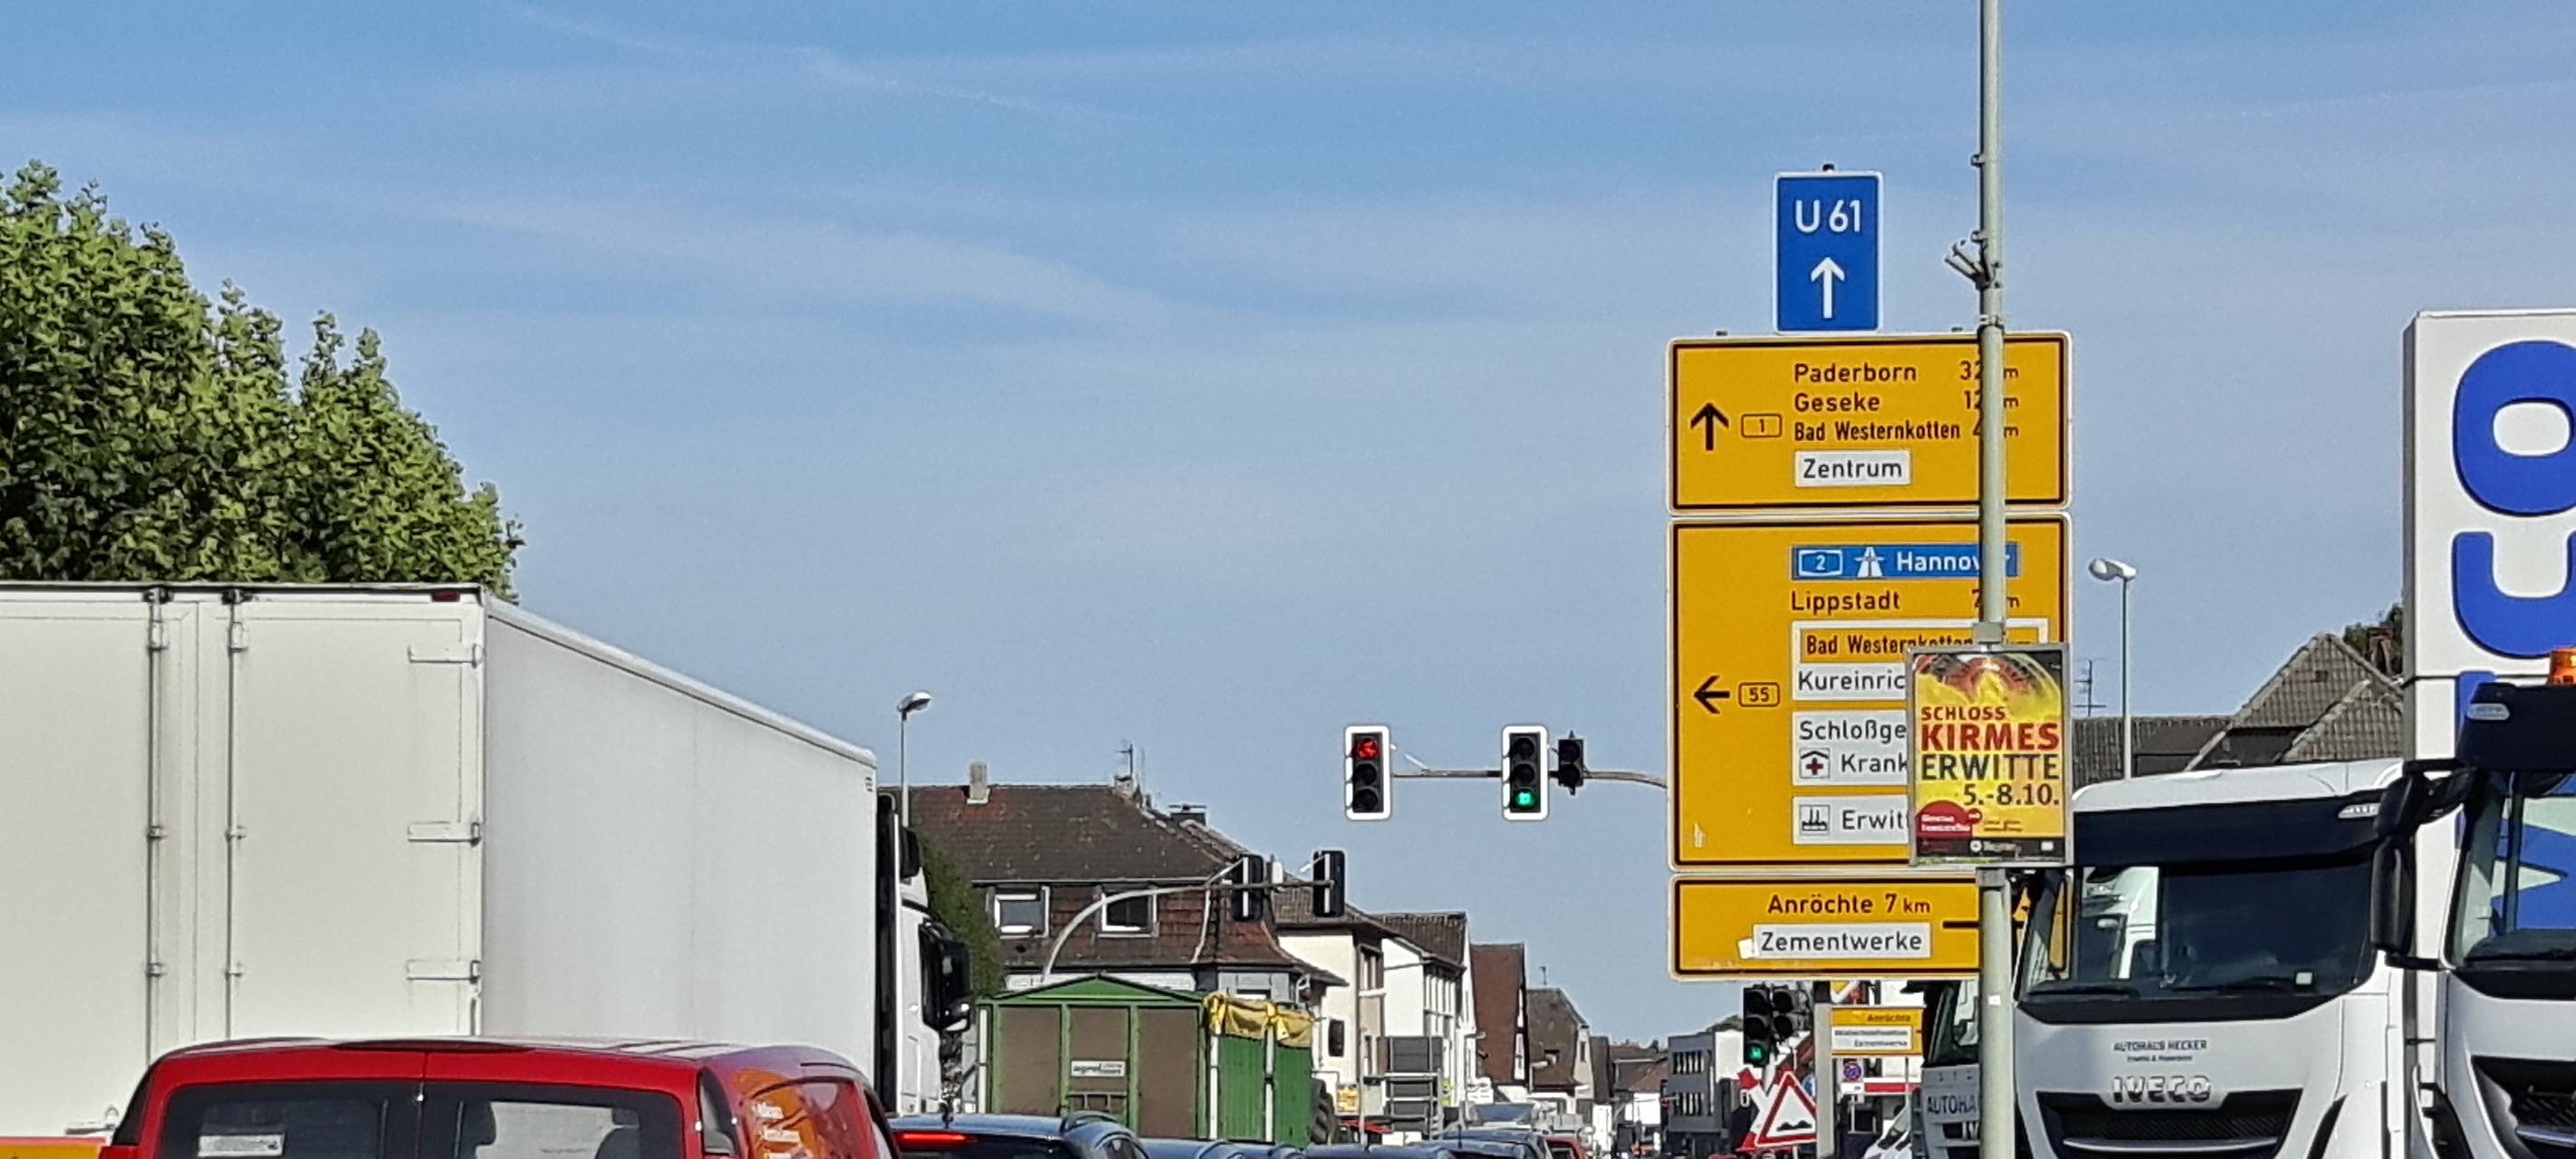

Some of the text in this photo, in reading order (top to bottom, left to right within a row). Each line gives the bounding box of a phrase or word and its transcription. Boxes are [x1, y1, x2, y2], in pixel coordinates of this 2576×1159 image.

[1795, 198, 1860, 234] U 61
[1794, 362, 1917, 383] Paderborn
[1794, 391, 1880, 412] Geseke
[1758, 418, 1765, 433] 1
[1794, 421, 1826, 441] Bad
[1834, 419, 1961, 441] Westernkotten
[1803, 458, 1902, 479] Zentrum
[1815, 554, 1826, 570] 2
[1792, 589, 1900, 617] Lippstadt
[1806, 634, 1838, 655] Bad
[1749, 686, 1770, 703] 55
[1920, 706, 2006, 721] SCHLOSS
[1921, 723, 2060, 752] KIRMES
[1921, 753, 2060, 781] ERWITTE
[1963, 782, 2060, 806] 5.-8.10.
[1841, 809, 1909, 830] Erwit
[1767, 893, 1931, 914] Anröchte 7 km
[1761, 930, 1923, 952] Zementwerke
[2113, 1075, 2211, 1103] IVECO
